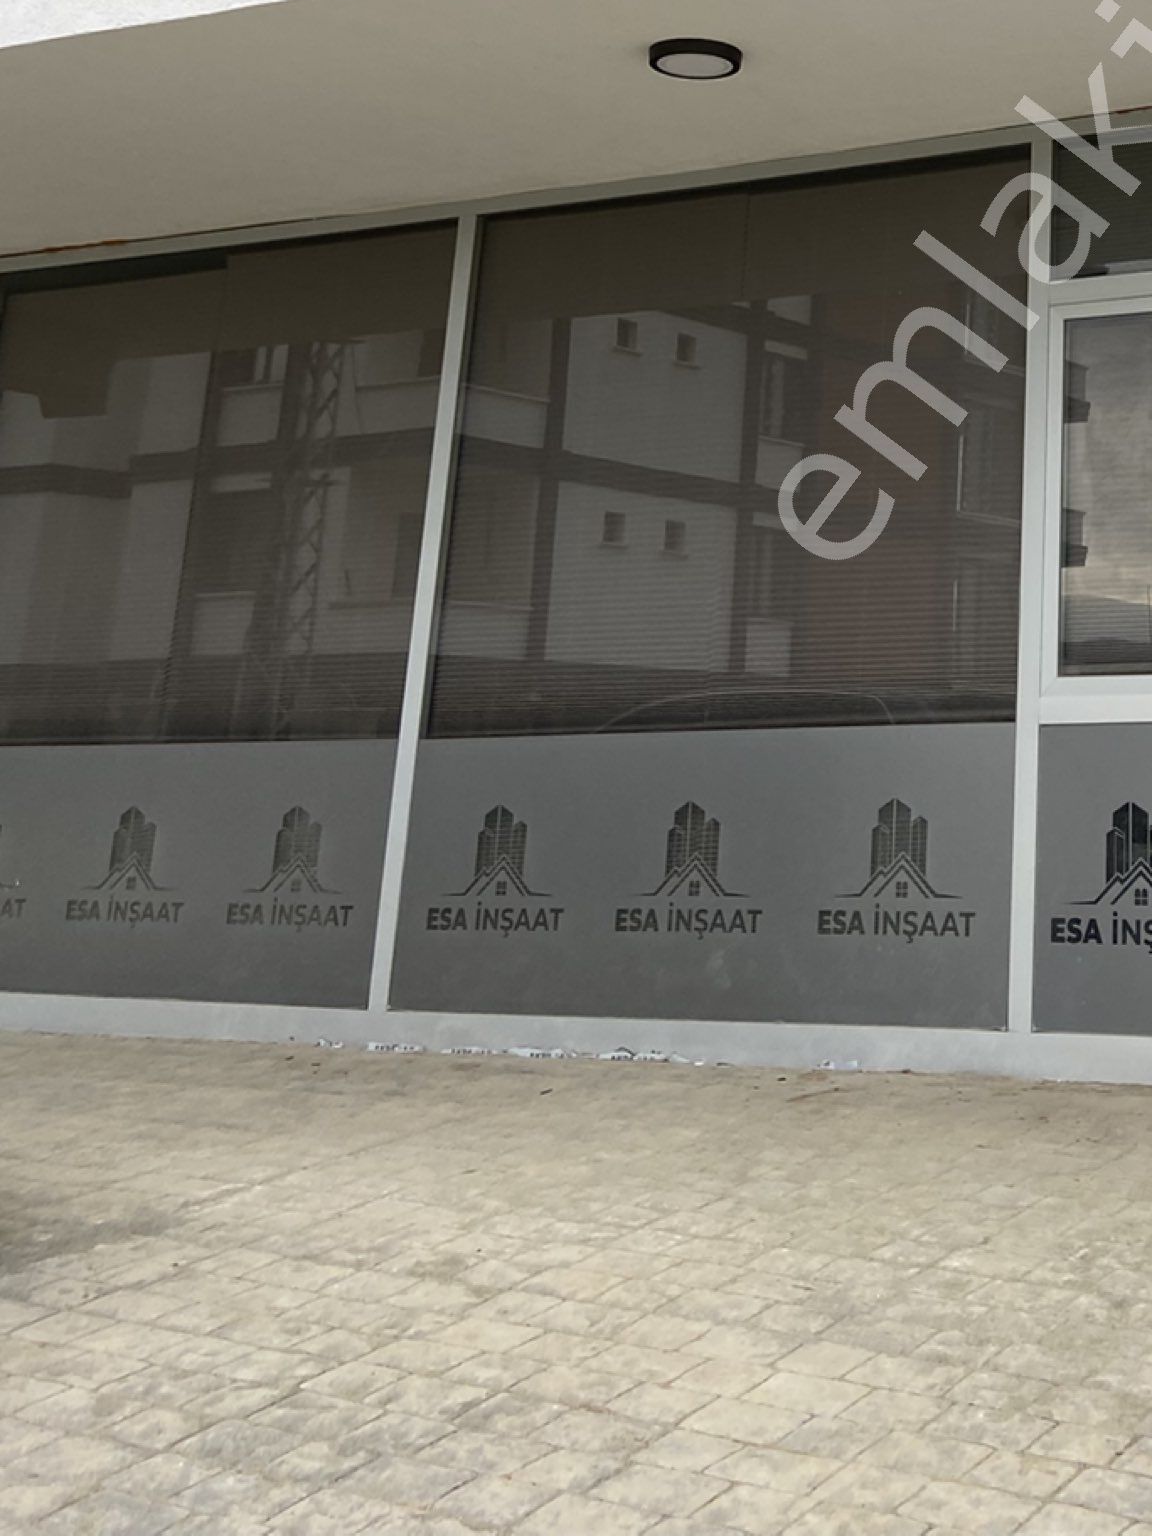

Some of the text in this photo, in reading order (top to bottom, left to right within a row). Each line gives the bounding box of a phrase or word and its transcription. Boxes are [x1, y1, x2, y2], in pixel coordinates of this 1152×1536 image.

[66, 894, 185, 928] ESA İNŞAAT
[226, 897, 355, 933] ESA İNŞAAT
[426, 901, 565, 938] ESA İNŞAAT
[614, 901, 763, 941] ESA İNŞAAT
[816, 902, 976, 944] ESA İNŞAAT
[1050, 917, 1103, 946] ESA
